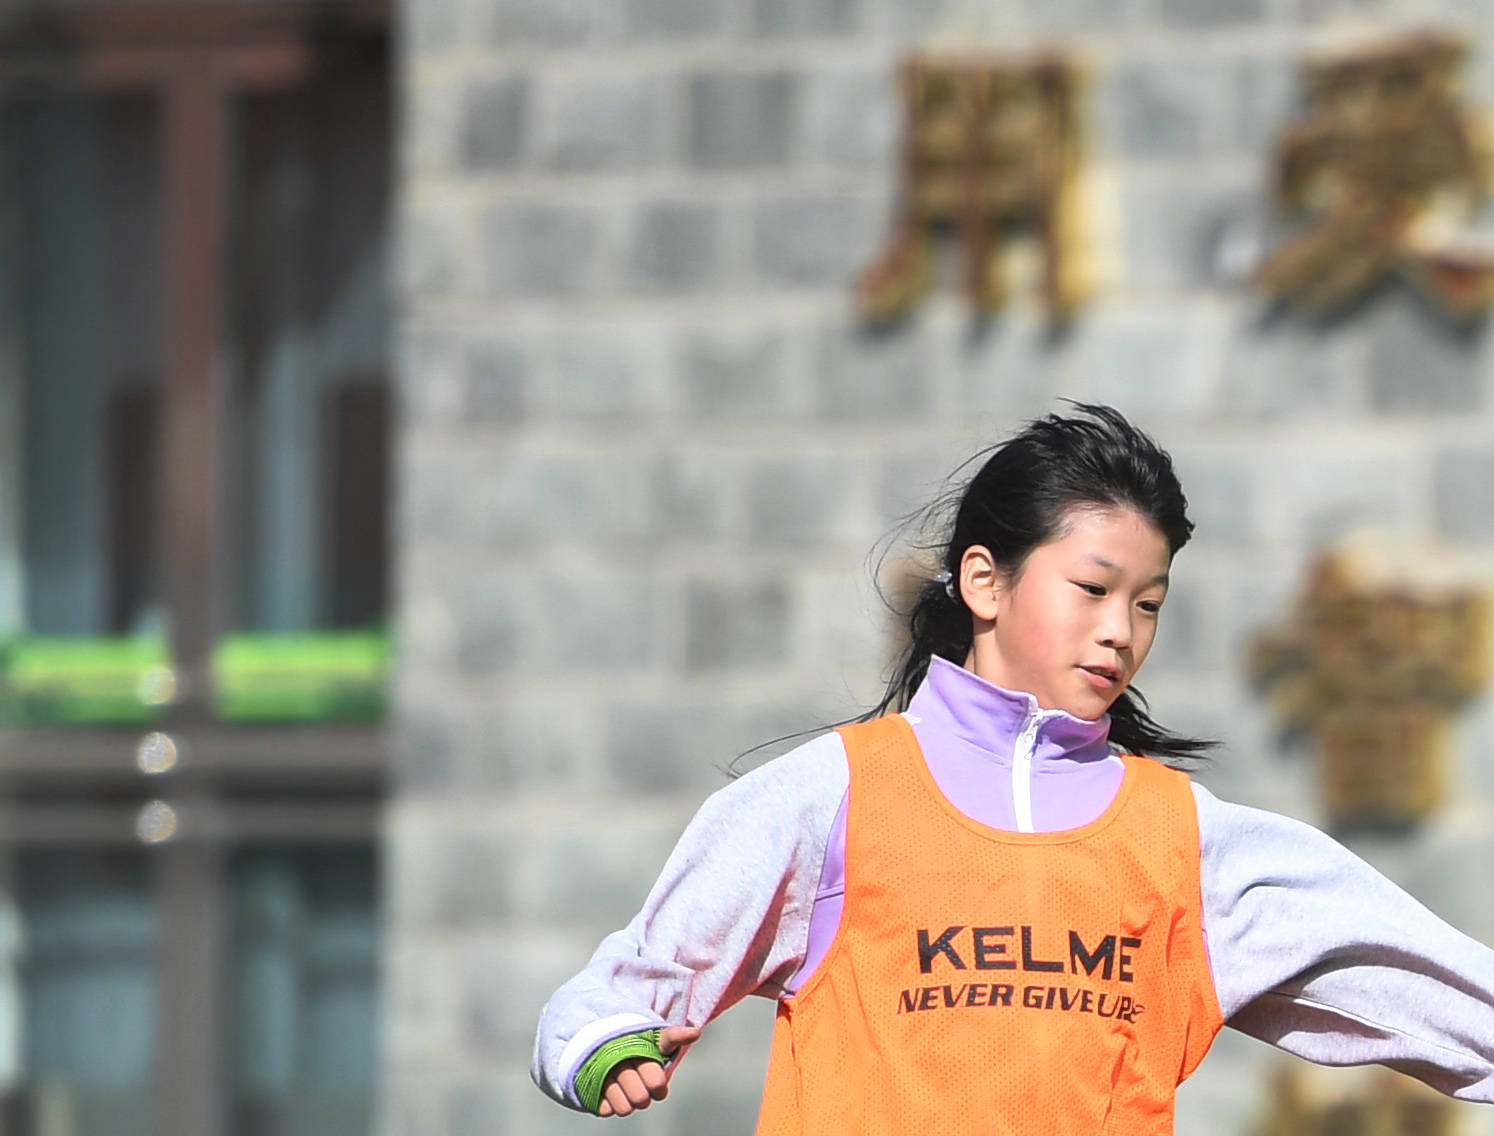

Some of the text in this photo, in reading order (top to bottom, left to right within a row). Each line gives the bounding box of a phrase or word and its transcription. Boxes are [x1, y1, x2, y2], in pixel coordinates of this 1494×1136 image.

[916, 925, 1142, 982] KELME
[897, 983, 1015, 1014] NEVER
[1022, 985, 1094, 1013] GIVE
